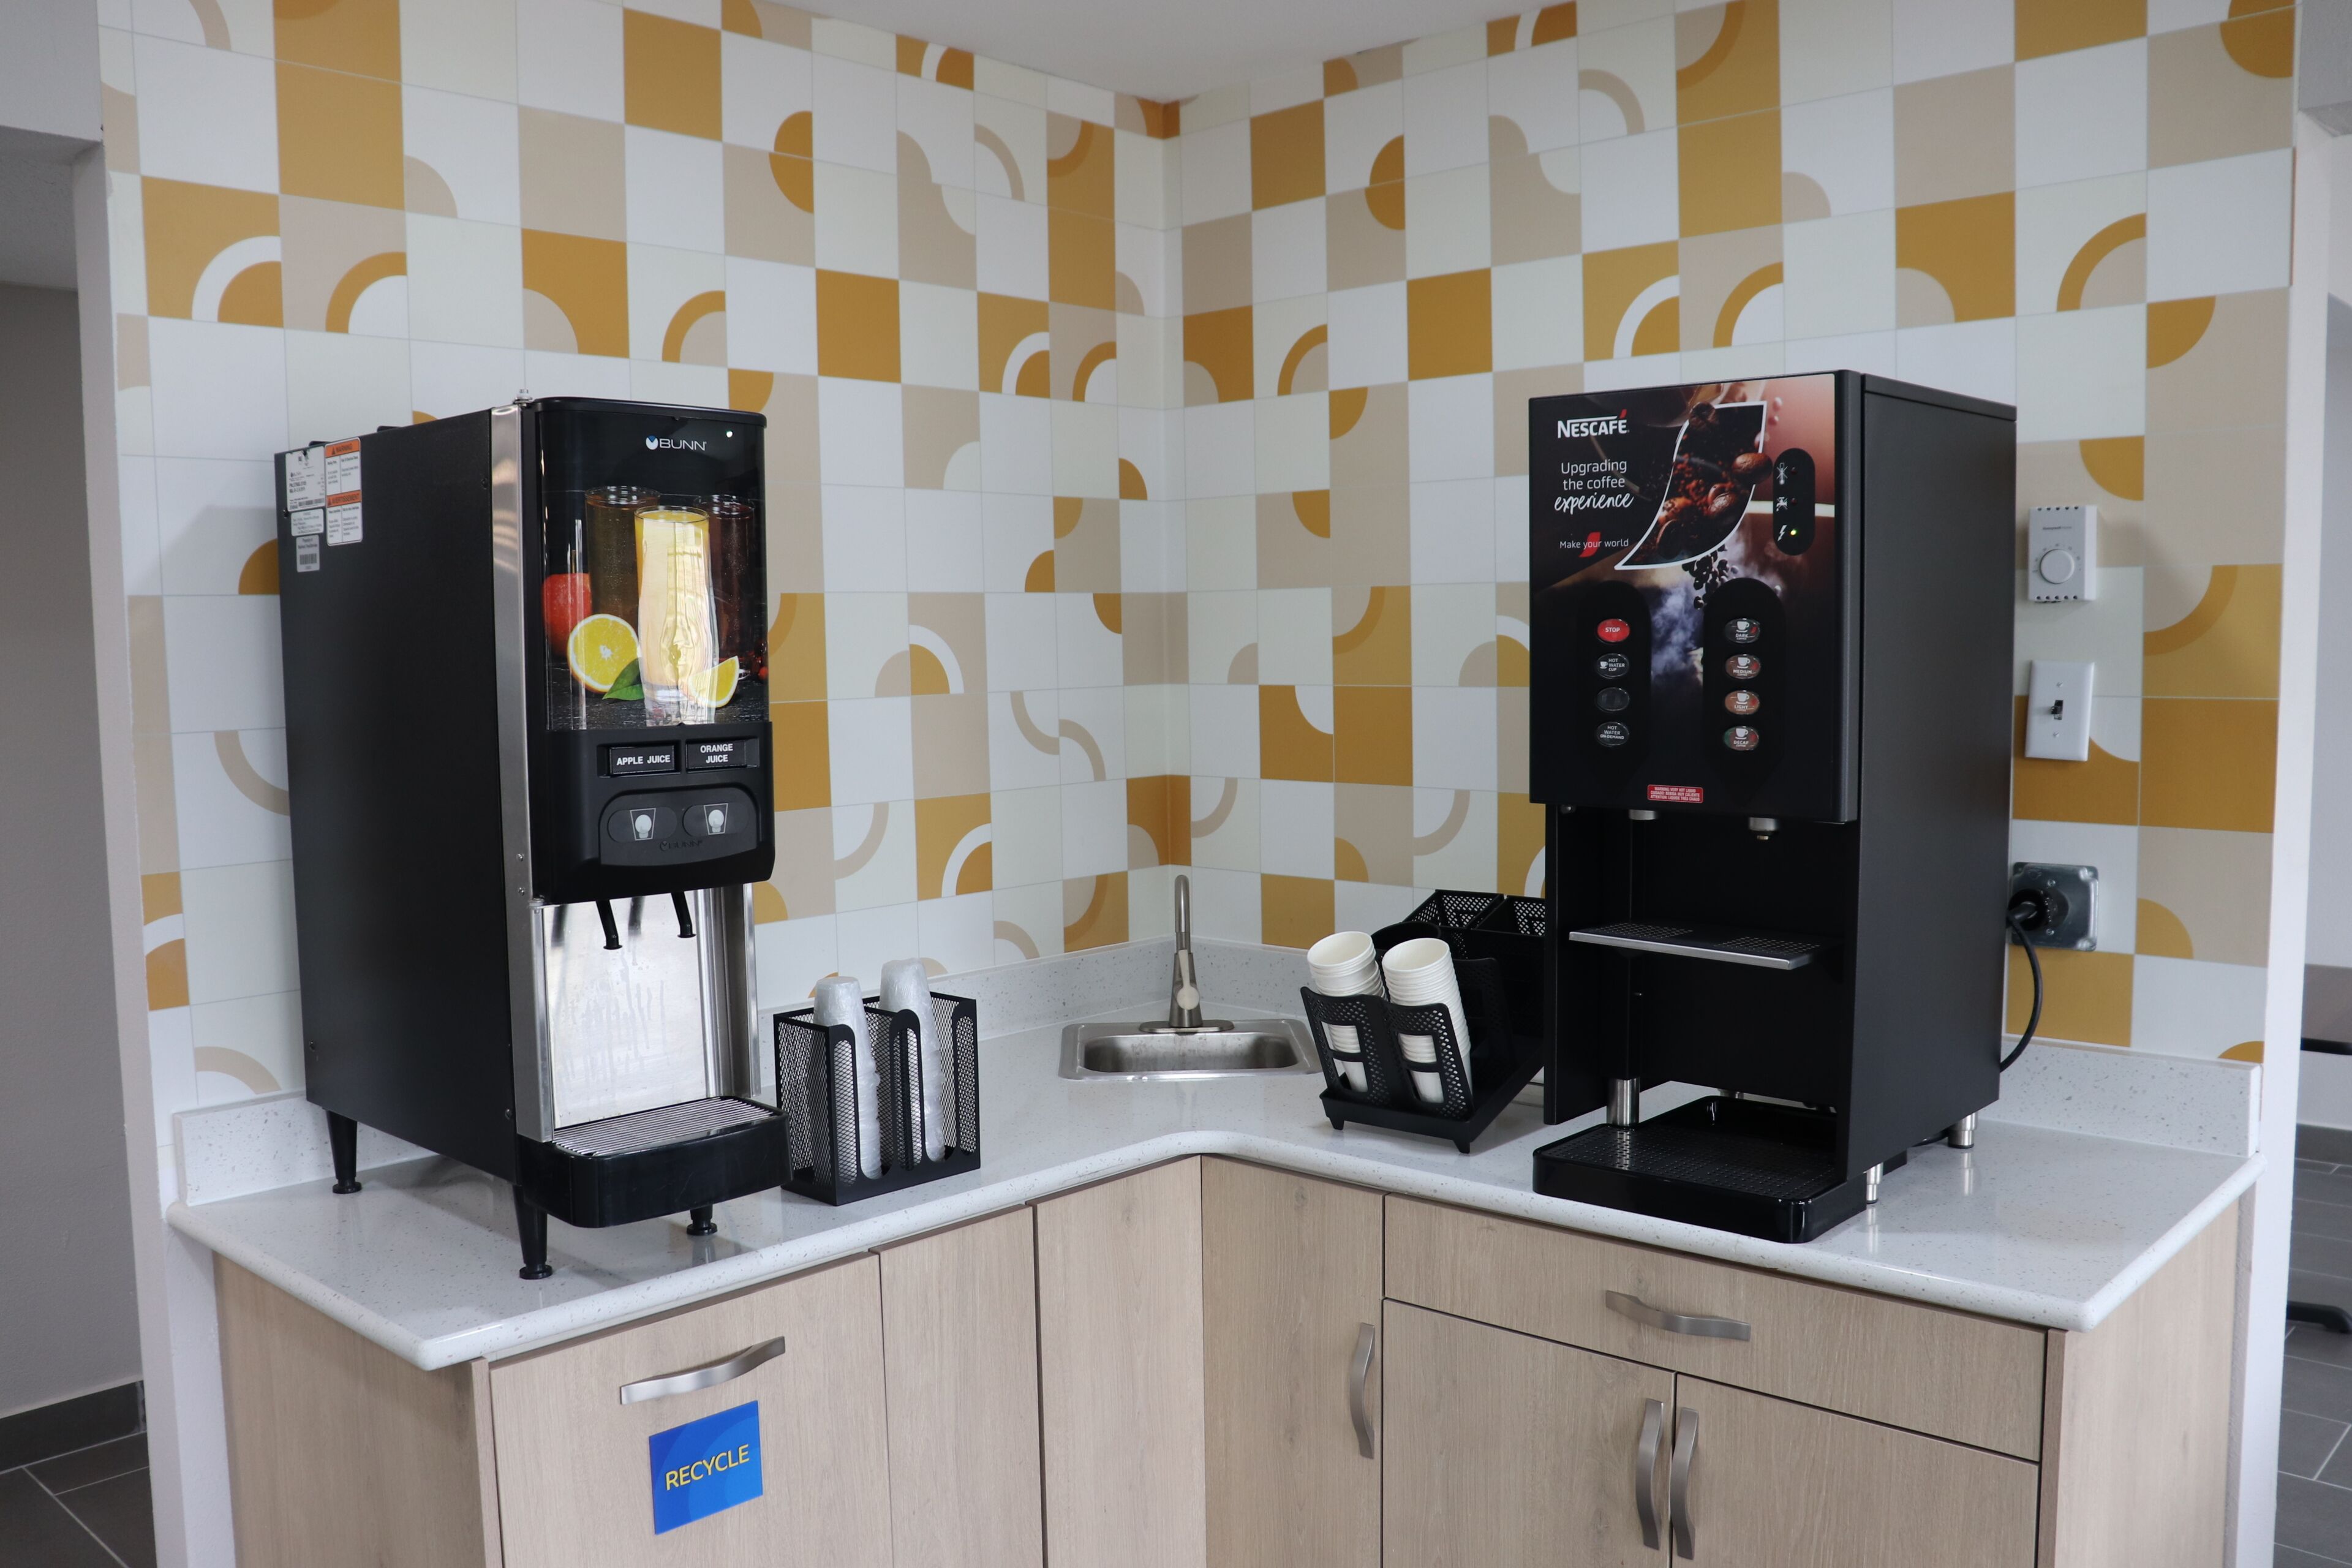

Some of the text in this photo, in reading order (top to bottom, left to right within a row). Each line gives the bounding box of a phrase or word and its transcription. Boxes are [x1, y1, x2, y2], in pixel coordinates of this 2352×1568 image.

[1558, 409, 1627, 439] NESCAFÉ
[660, 438, 706, 451] BUNN
[1561, 459, 1627, 476] Upgrading
[1563, 475, 1625, 490] the coffee
[1555, 492, 1634, 514] experience
[1559, 538, 1629, 550] Make your world
[700, 743, 733, 753] ORANGE
[616, 755, 671, 766] APPLE JUICE
[706, 755, 728, 764] JUICE
[665, 1444, 750, 1491] RECYCLE
